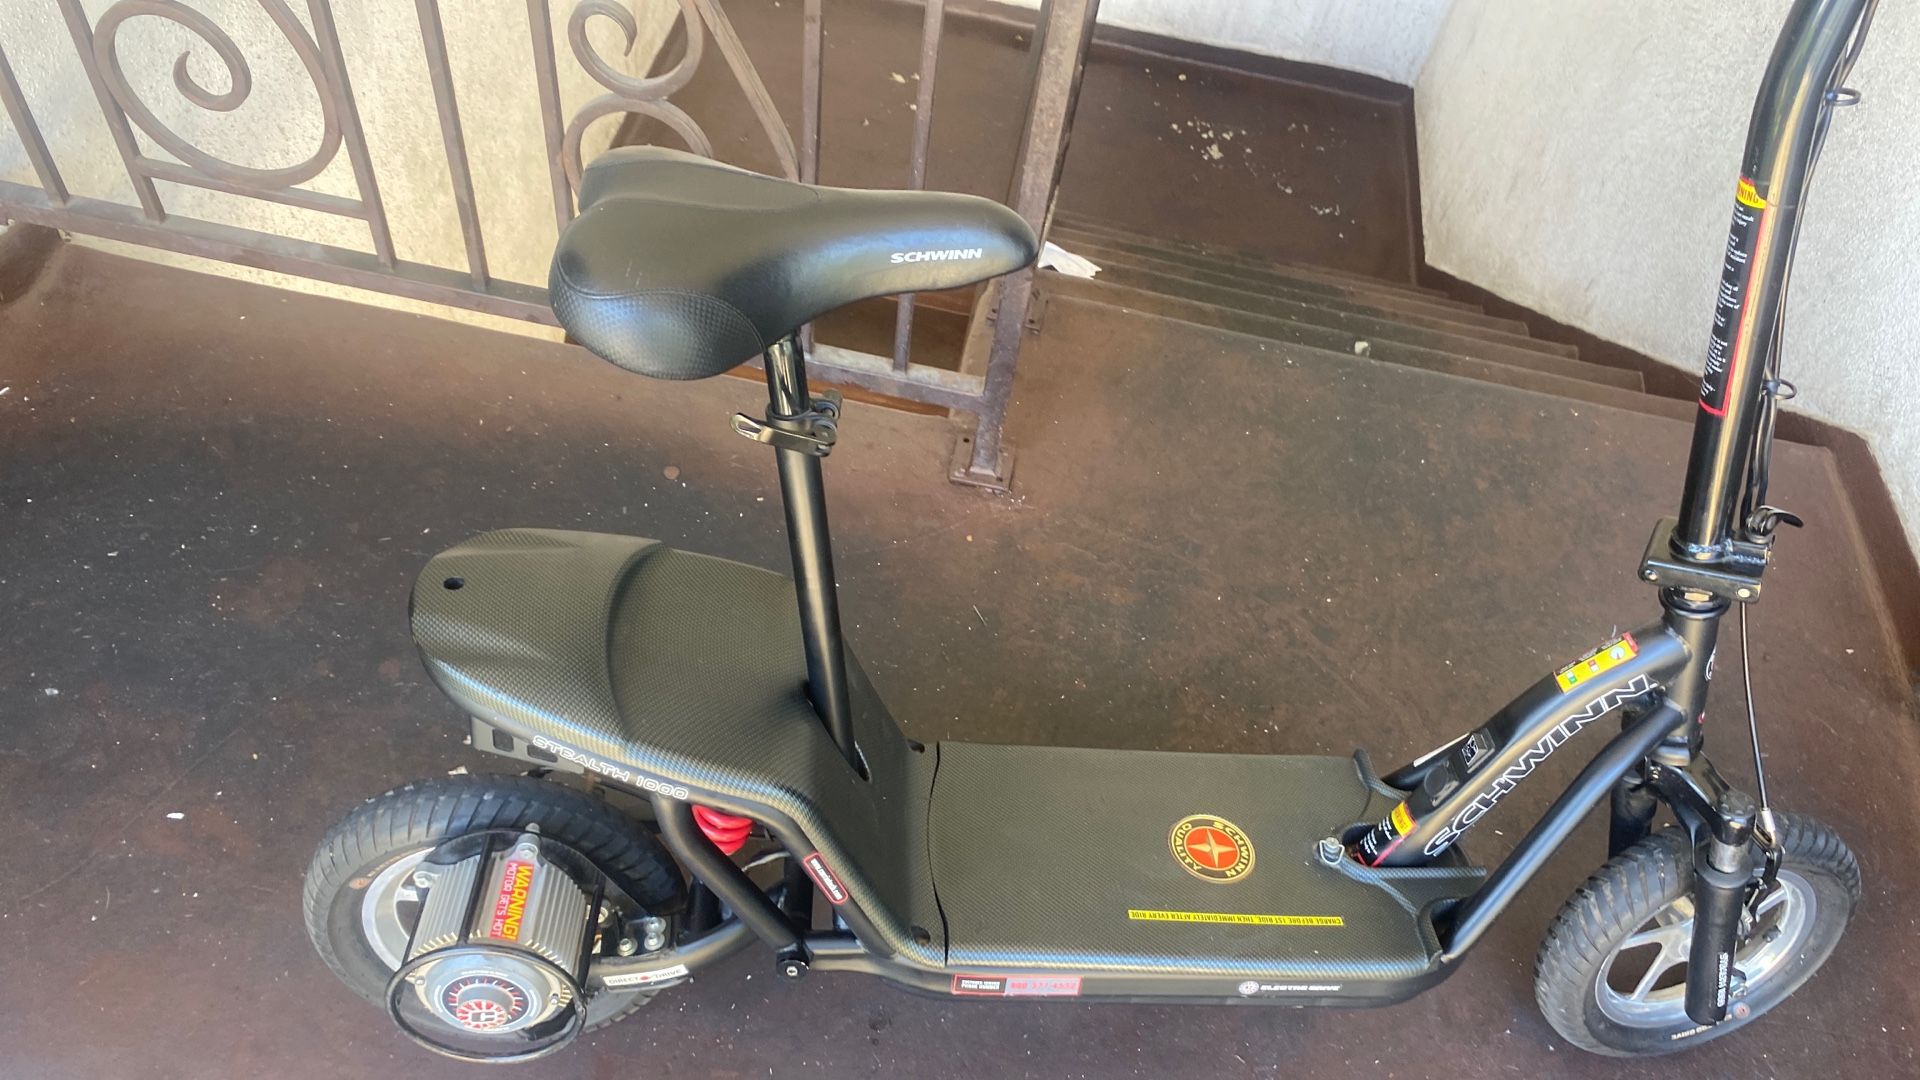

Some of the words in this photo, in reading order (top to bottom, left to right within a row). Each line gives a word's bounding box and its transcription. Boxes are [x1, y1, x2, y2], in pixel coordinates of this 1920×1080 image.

[890, 248, 983, 264] SCHWINN
[532, 734, 630, 783] STEALTH
[635, 774, 689, 801] 1000
[1424, 674, 1658, 857] SCHWINN
[1174, 822, 1202, 871] QUALITY
[1213, 821, 1249, 877] SCHWINN
[503, 863, 518, 892] MOTOR
[496, 894, 510, 916] GETS
[501, 865, 534, 940] WARNING!
[1131, 911, 1147, 919] RIDE
[1149, 912, 1169, 920] EVERY
[1170, 913, 1191, 921] AFTER
[1193, 914, 1236, 922] IMMEDIATELY
[1237, 915, 1253, 923] THEN
[1315, 917, 1341, 925] CHARGE
[491, 918, 504, 937] HOT
[608, 976, 639, 985] DIRECT
[655, 968, 681, 979] DRIVE
